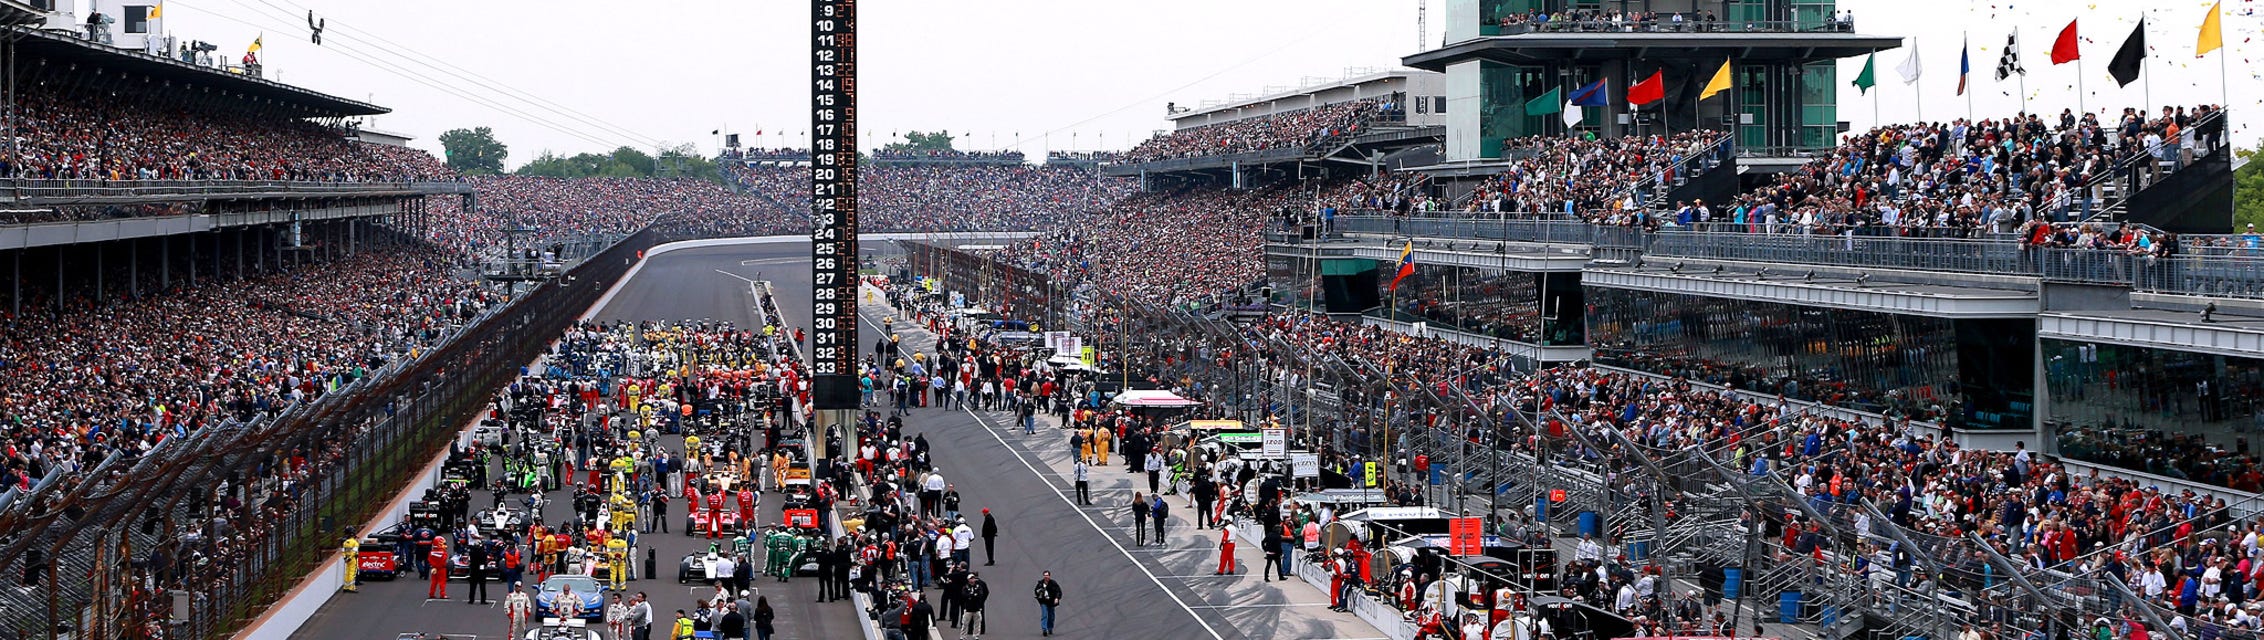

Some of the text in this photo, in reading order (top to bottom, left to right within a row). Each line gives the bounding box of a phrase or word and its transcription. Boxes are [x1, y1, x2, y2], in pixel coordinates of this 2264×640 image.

[824, 4, 853, 17] 9 27
[817, 20, 833, 31] 10
[818, 33, 854, 47] 11 98
[816, 48, 854, 62] 12 11
[816, 63, 854, 77] 13 22
[817, 78, 854, 91] 14 19
[817, 93, 854, 106] 15 7
[817, 108, 854, 121] 16 9
[817, 125, 834, 135] 17
[817, 139, 834, 150] 18
[817, 154, 834, 165] 19
[816, 167, 854, 181] 20 16
[816, 182, 854, 196] 21 77
[836, 197, 854, 211] 60
[846, 212, 854, 225] 8
[815, 227, 854, 240] 24 78
[816, 242, 854, 255] 25 21
[816, 257, 855, 270] 26 15
[817, 272, 855, 285] 27 6
[816, 287, 855, 300] 28 55
[816, 303, 835, 314] 29
[816, 316, 855, 330] 30 63
[817, 333, 835, 343] 31
[816, 347, 835, 358] 32
[817, 362, 835, 373] 33
[414, 511, 438, 519] verizon
[1547, 601, 1573, 609] verizon
